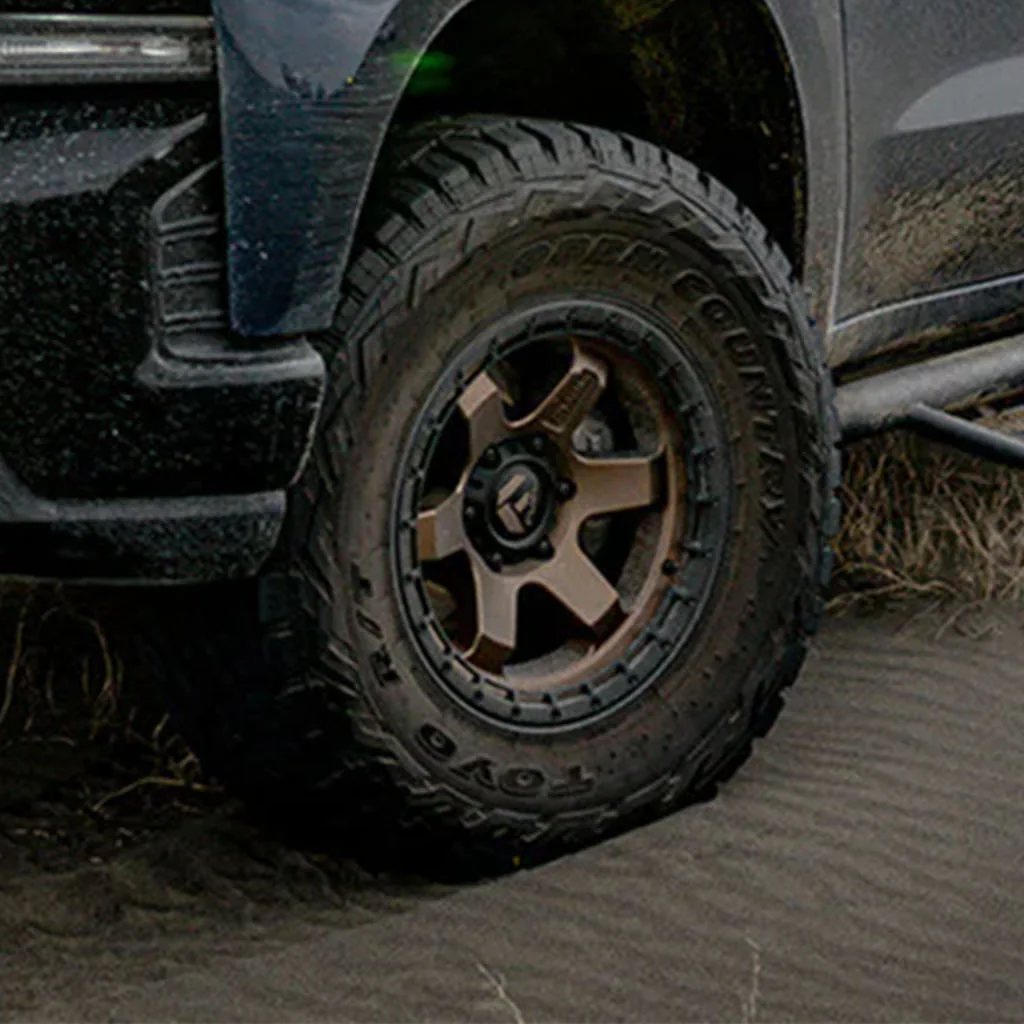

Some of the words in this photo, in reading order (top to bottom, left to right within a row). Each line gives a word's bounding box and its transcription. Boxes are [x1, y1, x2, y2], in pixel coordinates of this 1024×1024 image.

[511, 231, 670, 278] OPEN
[671, 267, 788, 548] COUNTRY
[413, 722, 597, 799] TOYO
